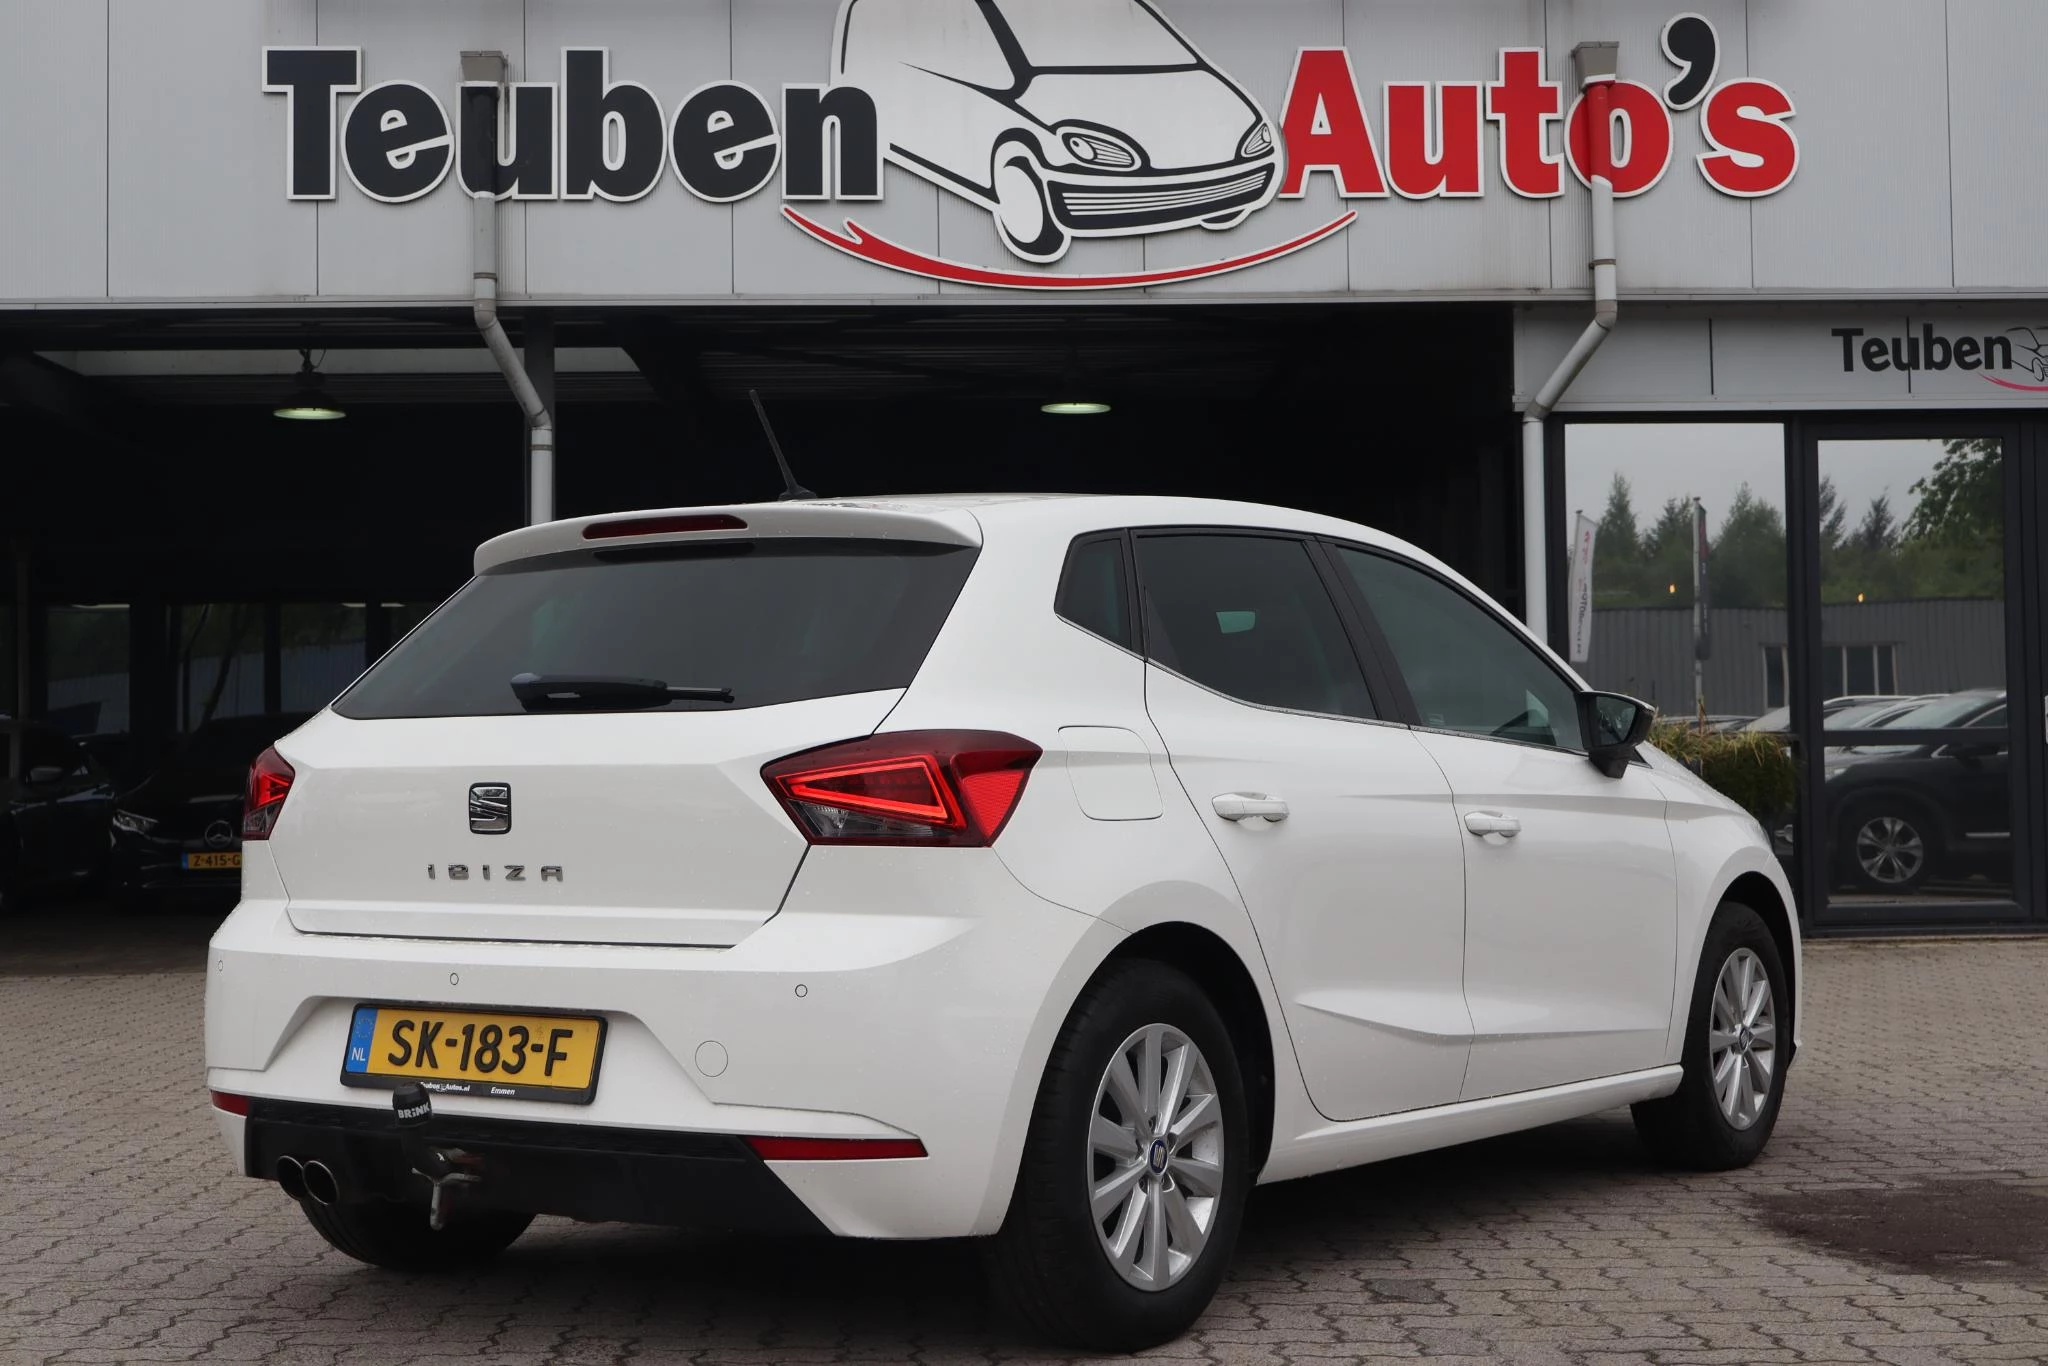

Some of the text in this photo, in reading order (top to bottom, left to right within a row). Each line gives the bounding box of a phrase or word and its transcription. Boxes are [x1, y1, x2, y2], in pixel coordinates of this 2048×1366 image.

[263, 13, 1800, 202] Teuben Auto's
[1831, 323, 2013, 372] Teuben
[427, 864, 563, 882] IBIZA
[351, 1047, 366, 1062] NL
[387, 1019, 574, 1077] SK-183-F
[490, 1086, 516, 1095] Emmen
